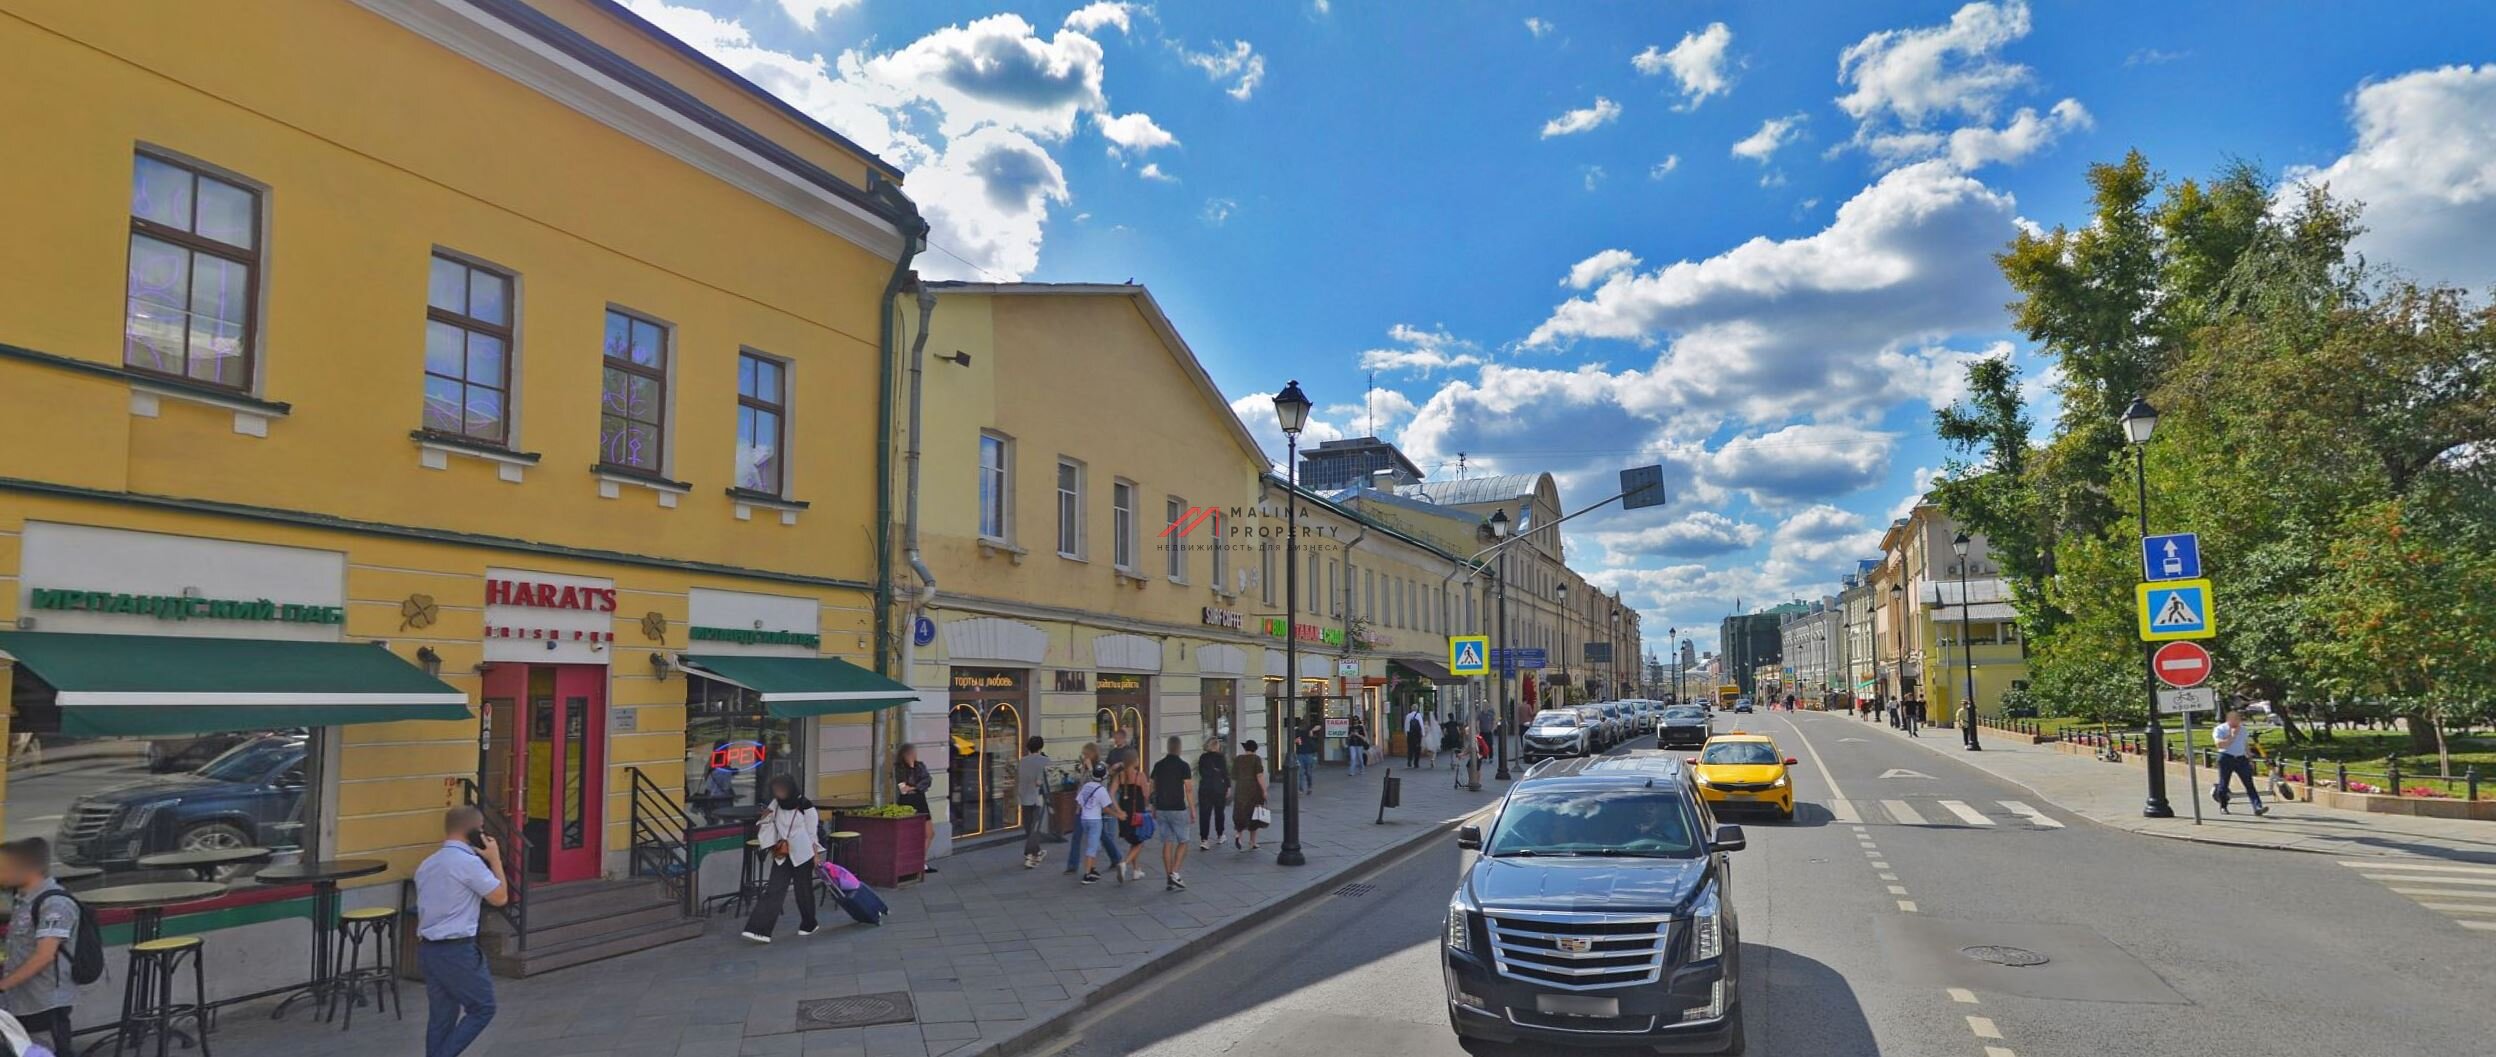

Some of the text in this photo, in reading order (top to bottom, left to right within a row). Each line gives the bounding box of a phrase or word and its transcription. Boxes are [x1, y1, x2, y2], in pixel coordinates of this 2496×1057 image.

[281, 603, 344, 624] ПАБ
[1203, 607, 1223, 626] SURF
[919, 622, 928, 636] 4
[954, 677, 977, 689] торты
[985, 672, 1013, 688] любовь
[711, 745, 766, 768] OPEN
